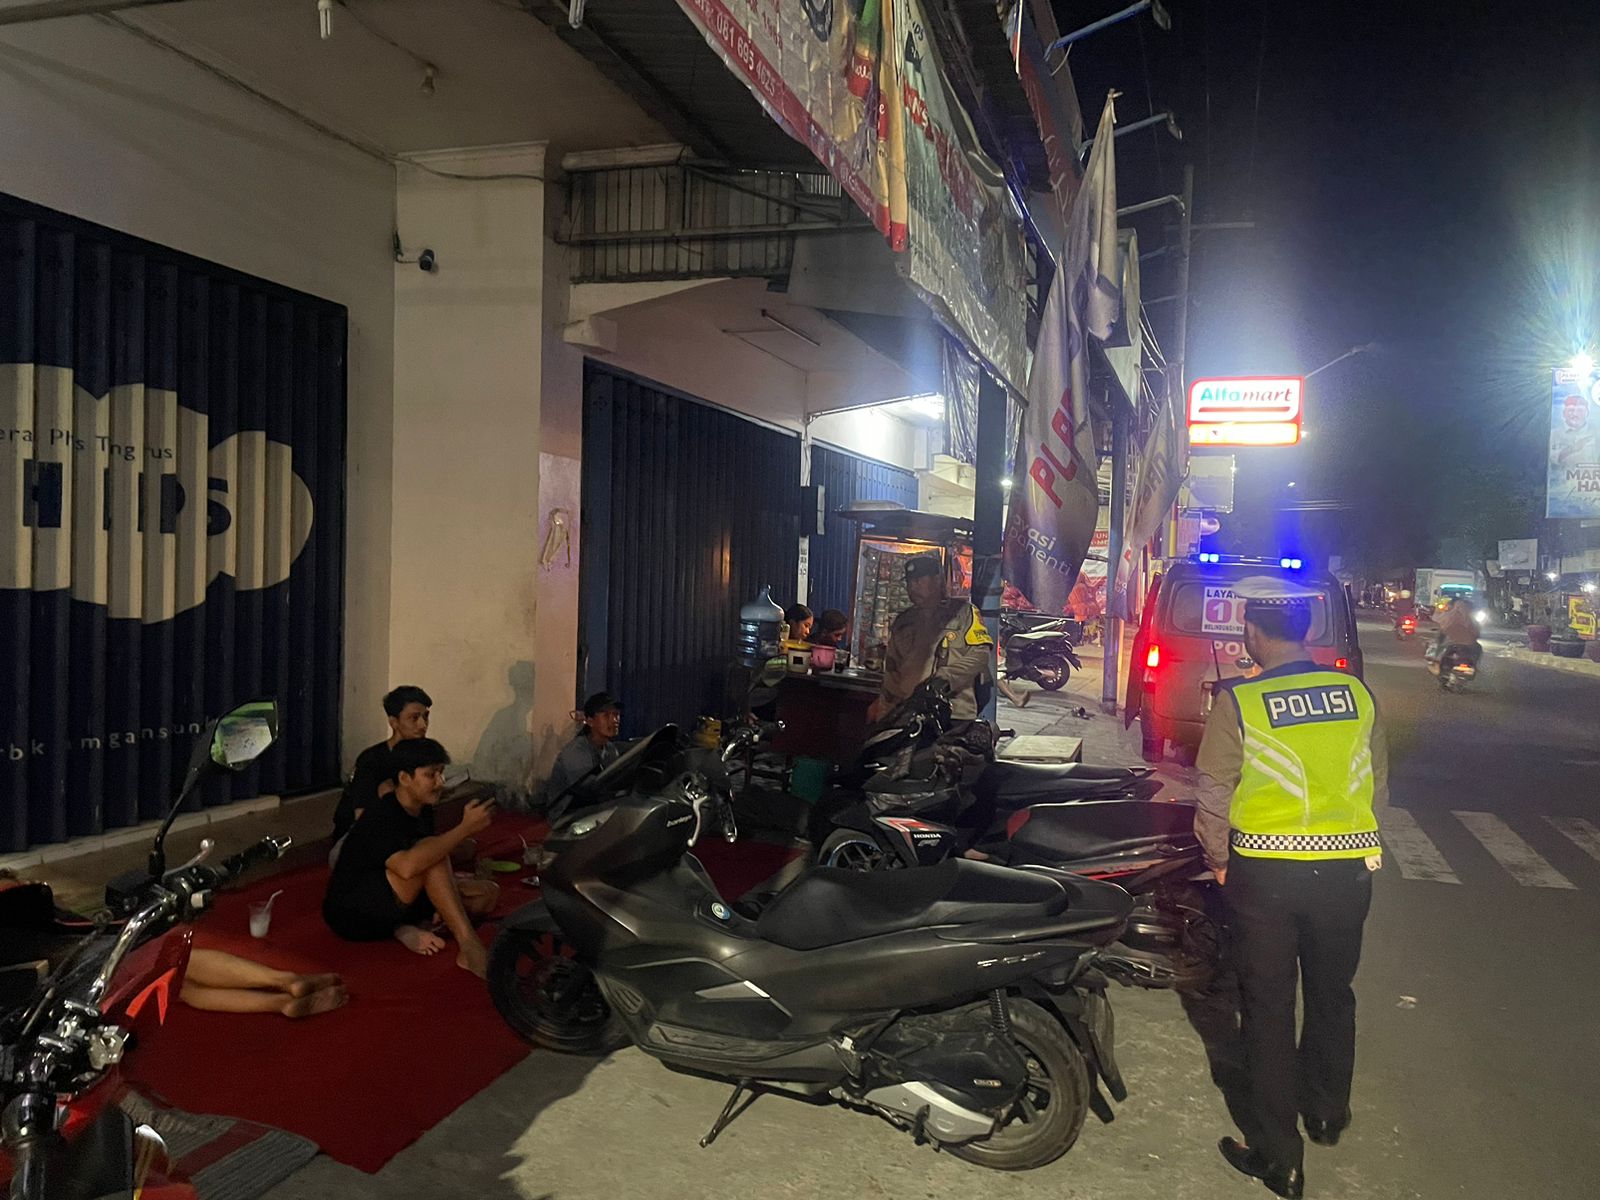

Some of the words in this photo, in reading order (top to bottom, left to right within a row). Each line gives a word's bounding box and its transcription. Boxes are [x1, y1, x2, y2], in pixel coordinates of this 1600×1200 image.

[716, 12, 734, 47] 081
[1200, 387, 1293, 402] Alfamart
[1269, 689, 1355, 720] POLISI
